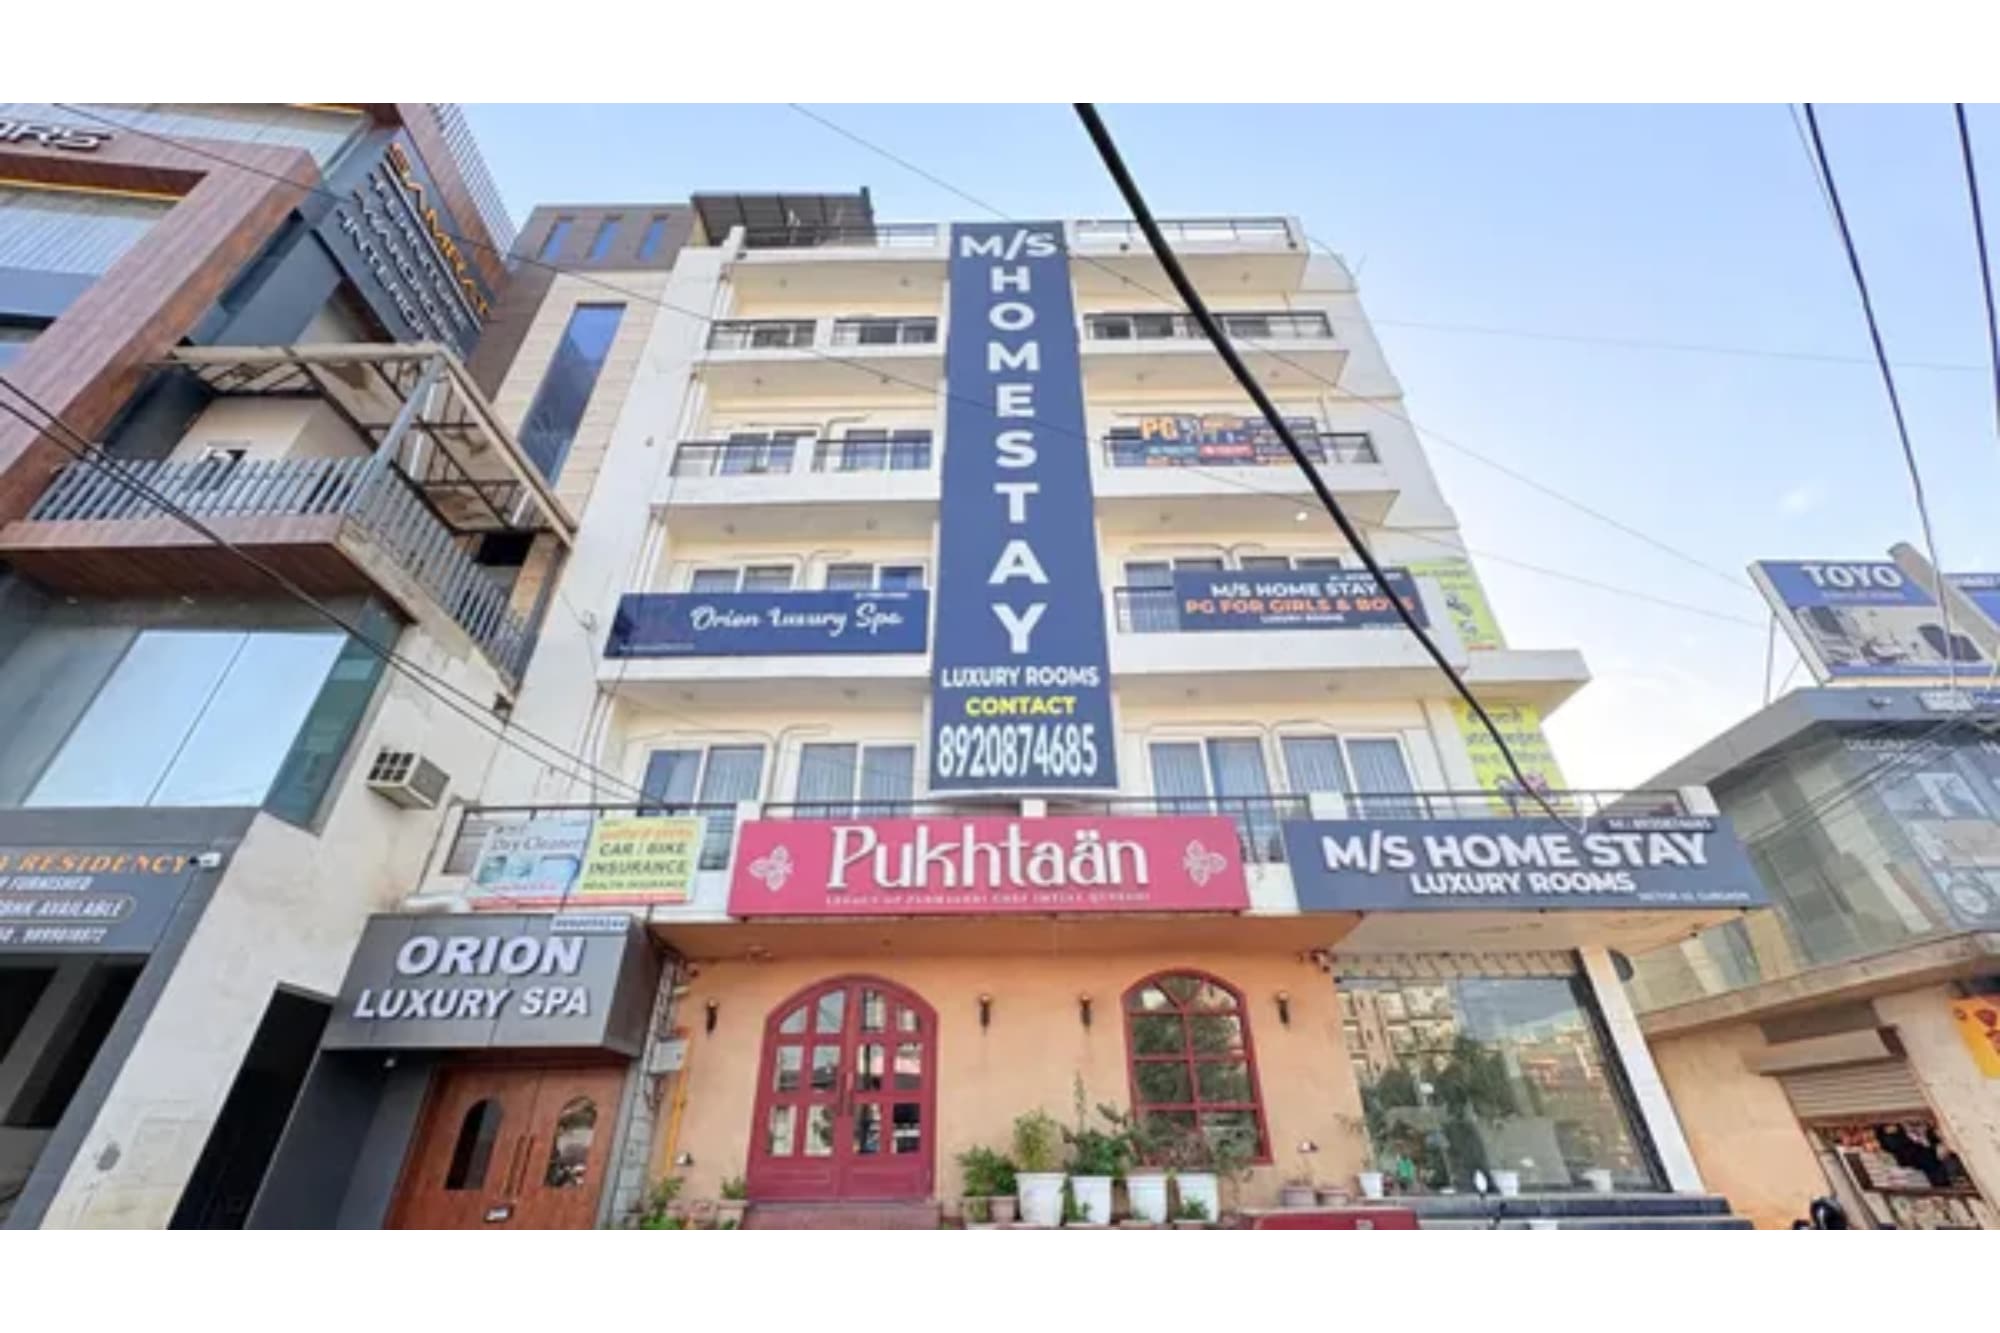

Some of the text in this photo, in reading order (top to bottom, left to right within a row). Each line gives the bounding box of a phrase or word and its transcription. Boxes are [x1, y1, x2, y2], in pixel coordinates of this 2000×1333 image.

[959, 230, 1058, 260] M/S
[1802, 565, 1903, 588] TOYO
[1211, 582, 1377, 598] M/S HOME STAY
[1186, 597, 1415, 613] PG FOR GIRLS & BOS
[690, 605, 760, 630] Orion
[855, 602, 903, 634] Spa
[942, 666, 1099, 688] LUXURY ROOMS
[965, 696, 1076, 716] CONTACT
[938, 724, 1097, 777] 8920874685
[600, 843, 634, 857] CAR
[646, 842, 687, 855] BIKE
[1322, 830, 1708, 873] M/S HOME STAY
[20, 855, 187, 873] RESIDENCY
[589, 860, 687, 875] INSURANCE
[1411, 871, 1636, 895] LUXURY ROOMS
[37, 899, 123, 917] AVAILABLE
[396, 935, 586, 975] ORION
[353, 985, 589, 1018] LUXURY SPA
